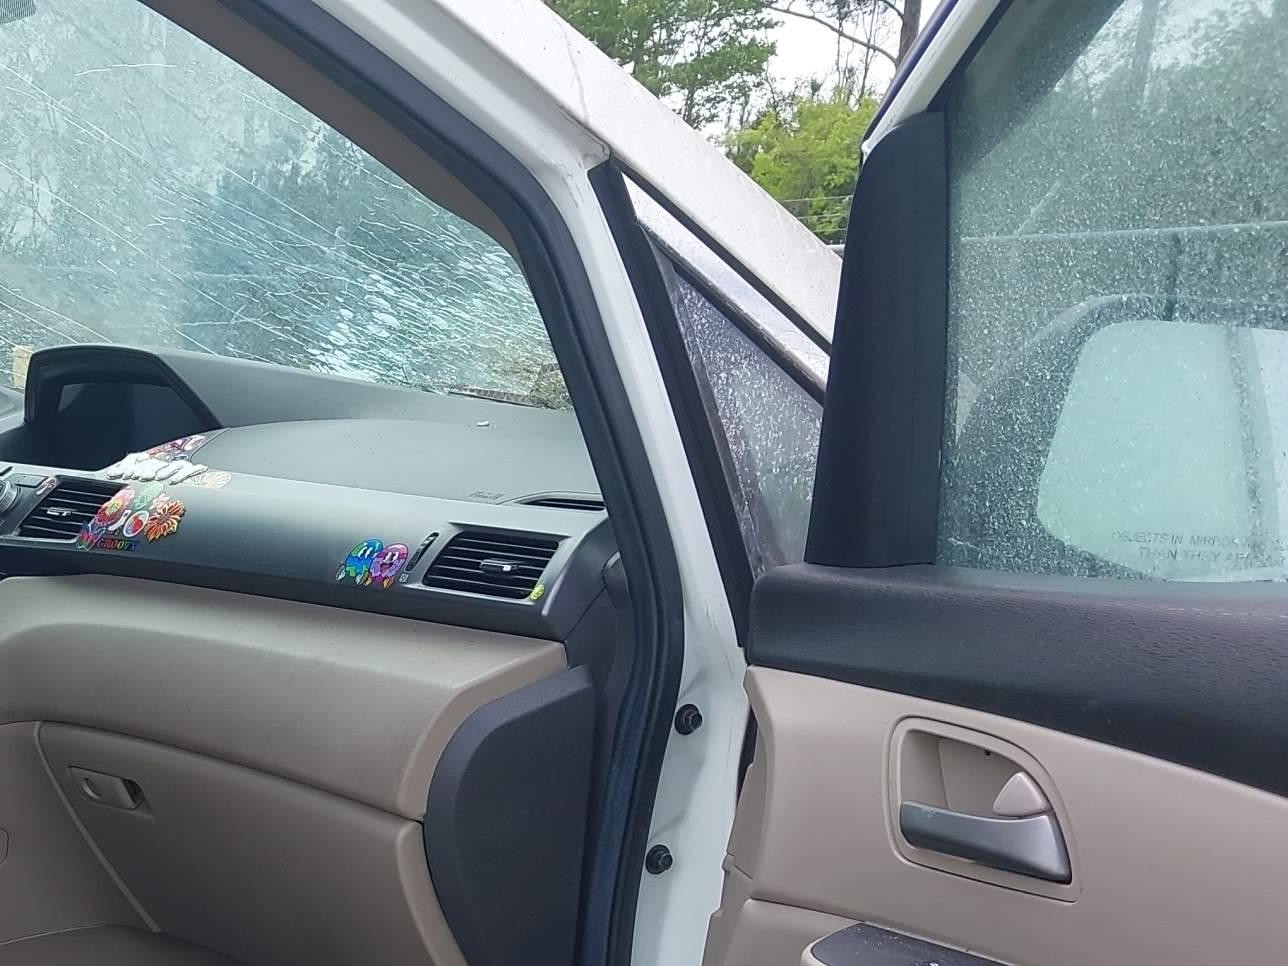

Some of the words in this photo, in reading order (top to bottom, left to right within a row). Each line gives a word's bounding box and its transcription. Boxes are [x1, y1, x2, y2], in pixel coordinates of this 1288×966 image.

[97, 538, 139, 551] GROOVY
[1112, 530, 1169, 544] OBJECTS
[1171, 534, 1184, 545] IN
[1190, 534, 1240, 548] MIRROR
[1139, 546, 1178, 560] THAN
